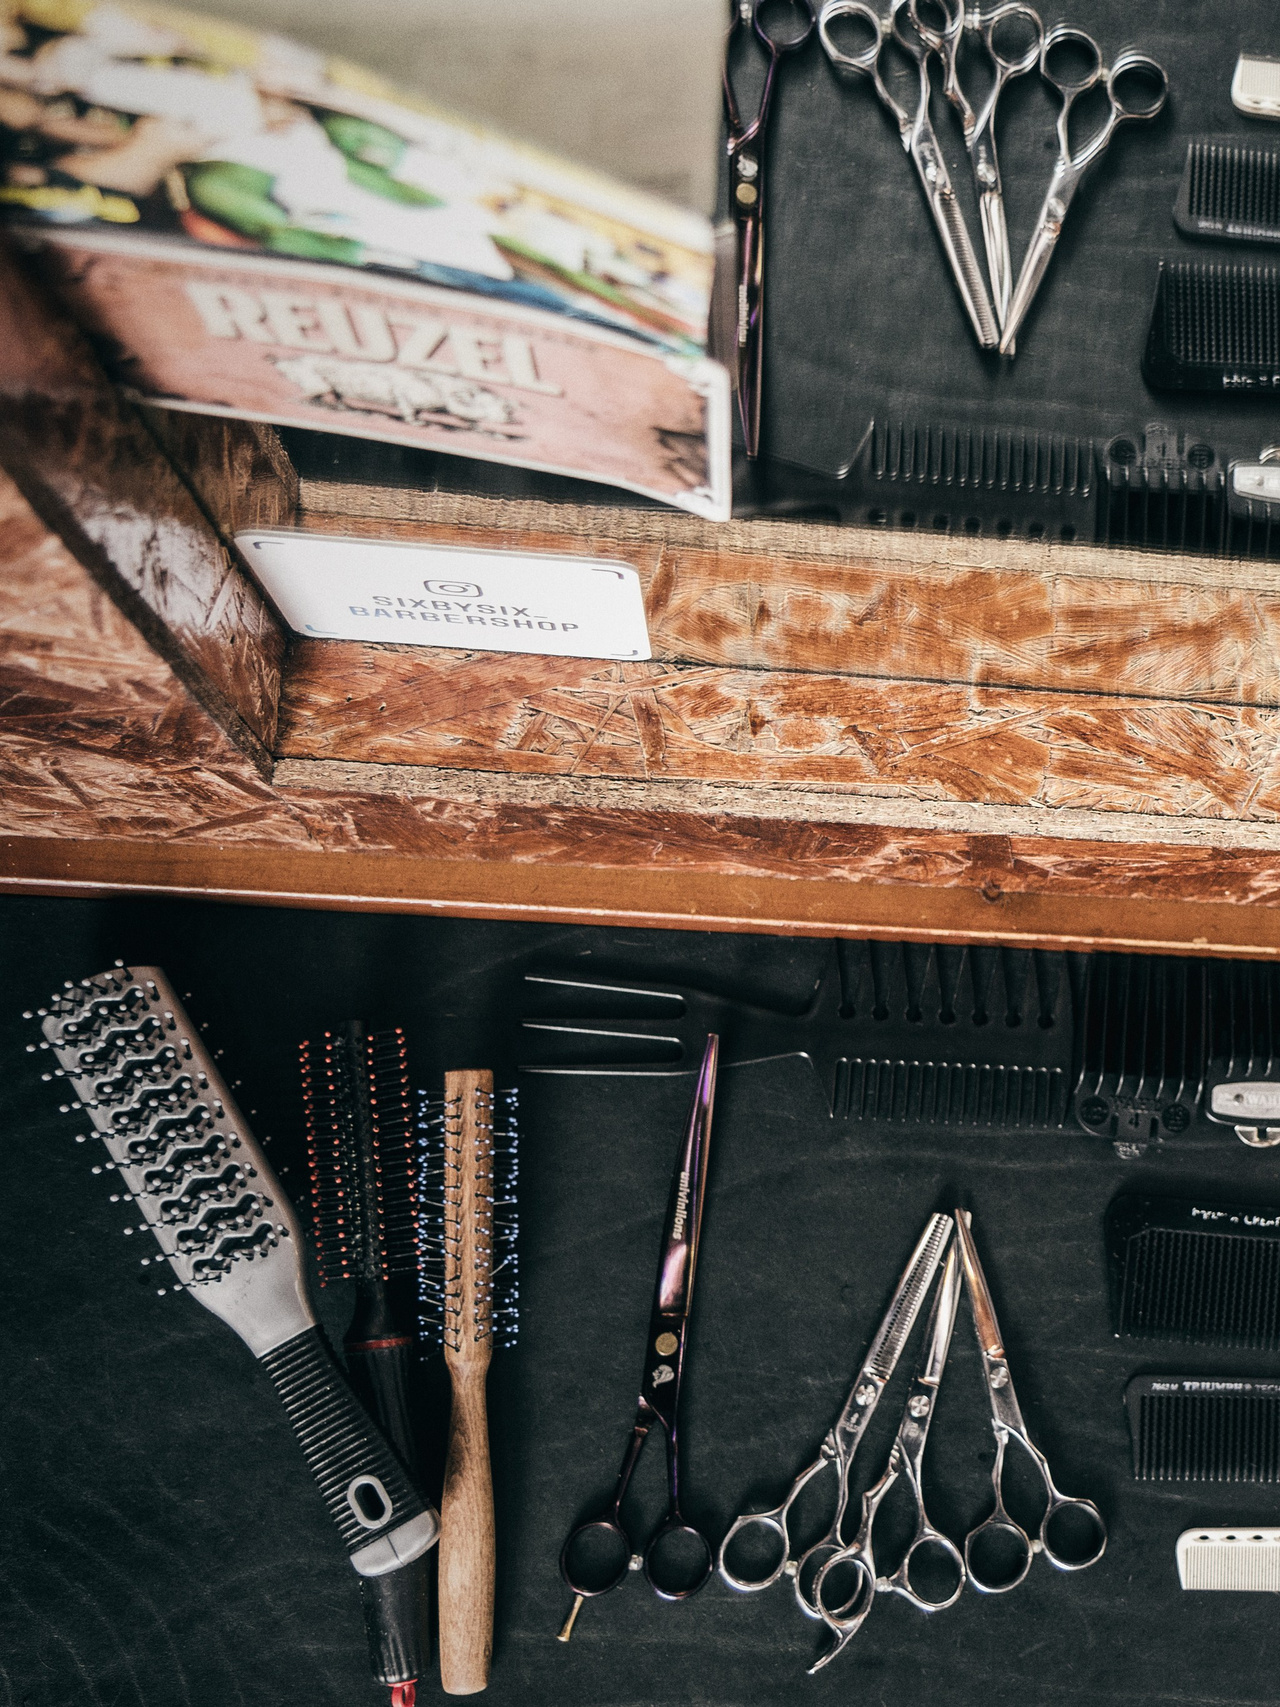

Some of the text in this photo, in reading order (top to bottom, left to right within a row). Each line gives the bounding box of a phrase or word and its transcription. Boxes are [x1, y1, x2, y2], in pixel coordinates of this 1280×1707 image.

[185, 280, 564, 395] REUZEL
[348, 605, 580, 632] BARBERSHOP
[371, 595, 549, 620] SIXBYSIX_
